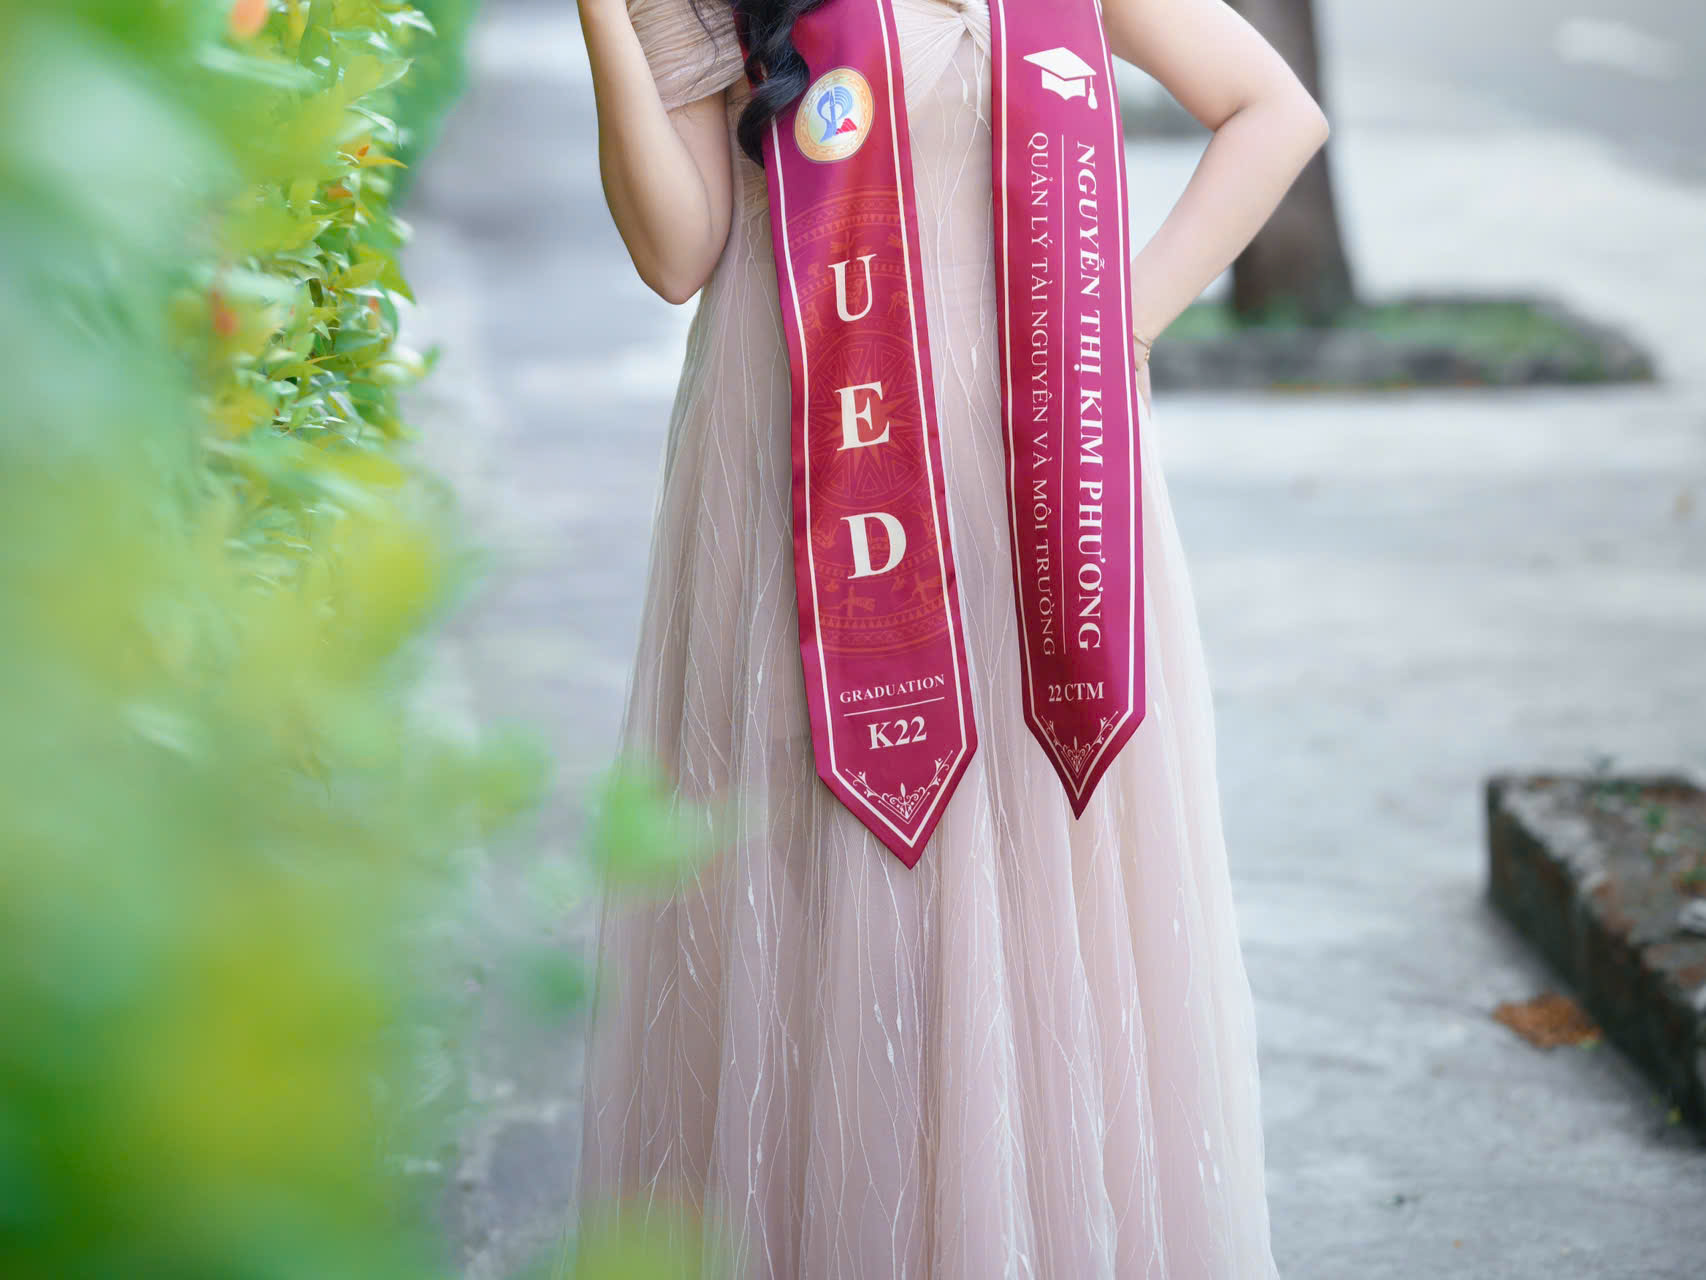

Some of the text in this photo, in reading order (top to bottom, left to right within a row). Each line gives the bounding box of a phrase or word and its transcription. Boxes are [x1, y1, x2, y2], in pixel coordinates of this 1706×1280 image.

[1027, 131, 1056, 656] QUẢN LÝ TÀI NGUYÊN VÀ MÔI TRƯỜNG
[1073, 140, 1106, 652] NGUYỄN THỊ KIM PHƯƠNG
[839, 673, 945, 704] GRADUATION
[867, 715, 927, 750] K22
